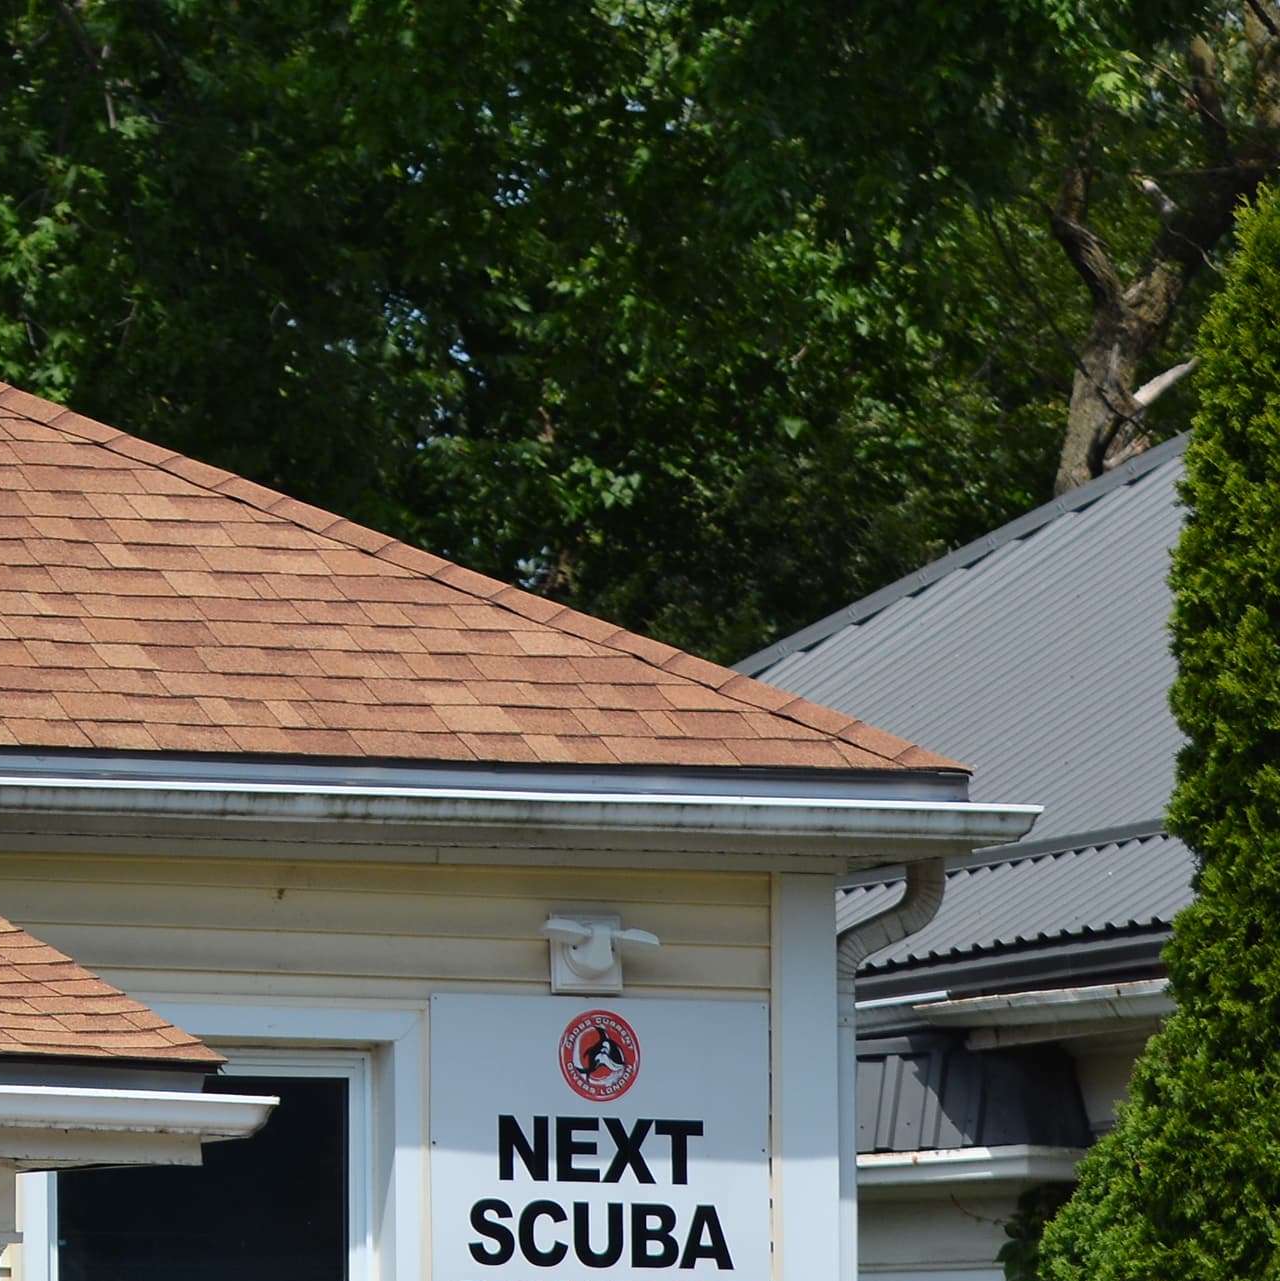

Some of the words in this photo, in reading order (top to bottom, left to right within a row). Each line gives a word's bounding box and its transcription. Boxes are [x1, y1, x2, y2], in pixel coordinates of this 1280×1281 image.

[565, 1019, 593, 1049] CROSS
[595, 1017, 635, 1051] CURRENT
[567, 1062, 596, 1095] DIVERS
[599, 1064, 634, 1096] LONDON
[497, 1114, 704, 1185] NEXT
[467, 1198, 734, 1270] SCUBA
